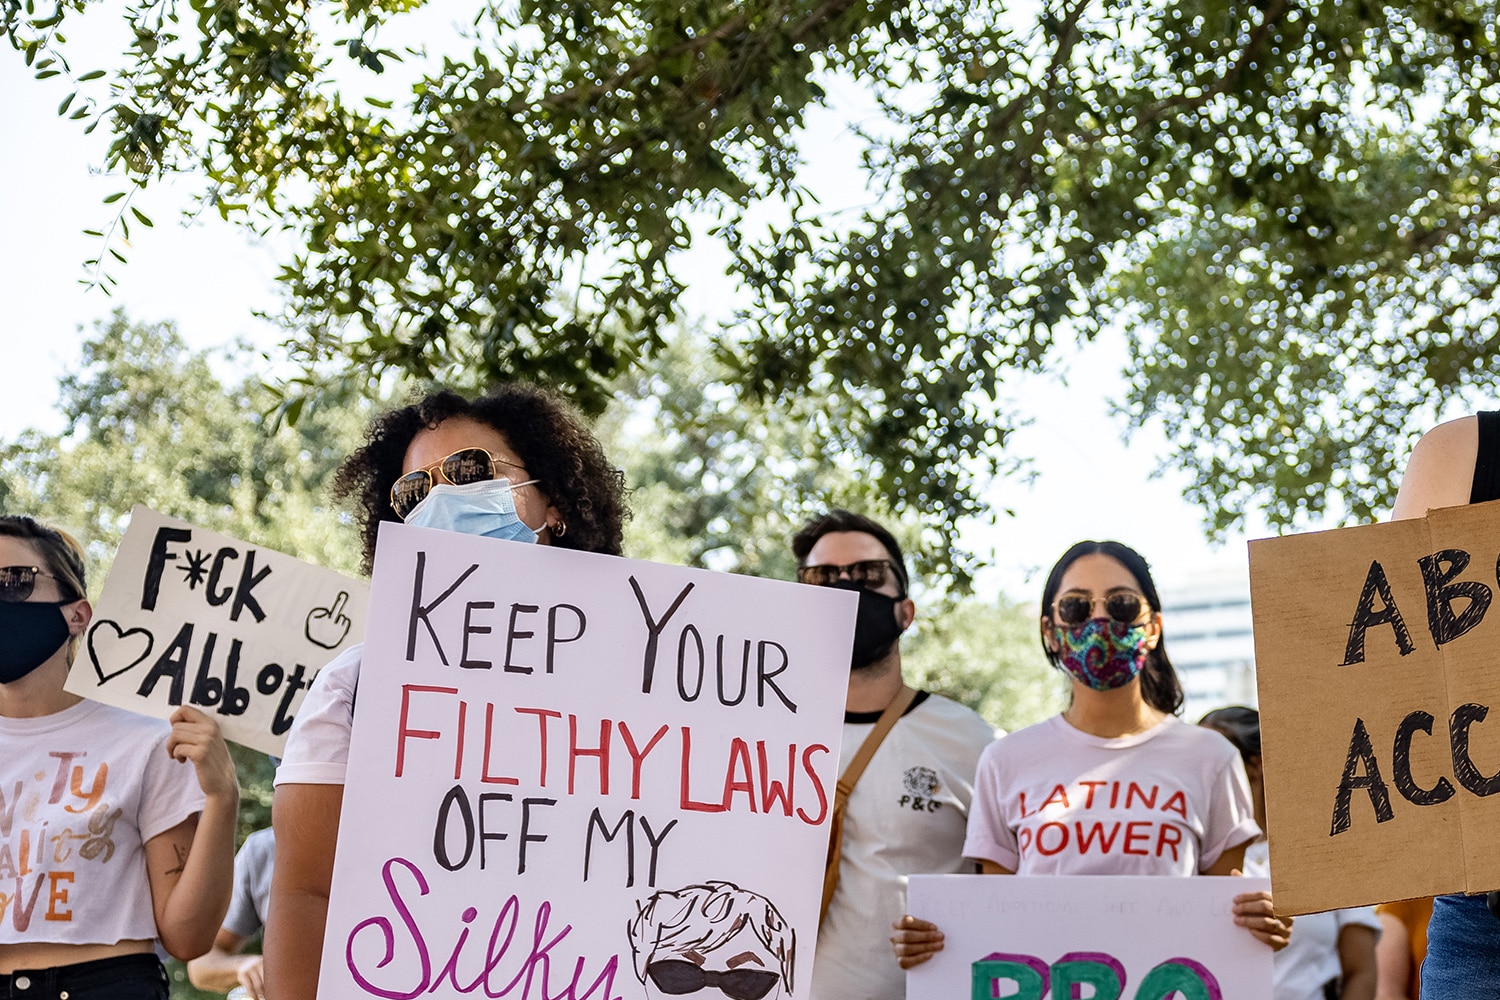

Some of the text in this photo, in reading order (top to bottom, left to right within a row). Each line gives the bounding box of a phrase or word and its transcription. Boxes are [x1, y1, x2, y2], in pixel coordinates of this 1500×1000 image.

[137, 623, 320, 735] Abbot
[406, 551, 797, 713] KEEP YOUR
[395, 683, 830, 826] FILTHY LAWS
[1018, 781, 1188, 821] LATINA
[433, 784, 678, 887] OFF MY
[1019, 820, 1183, 863] POWER
